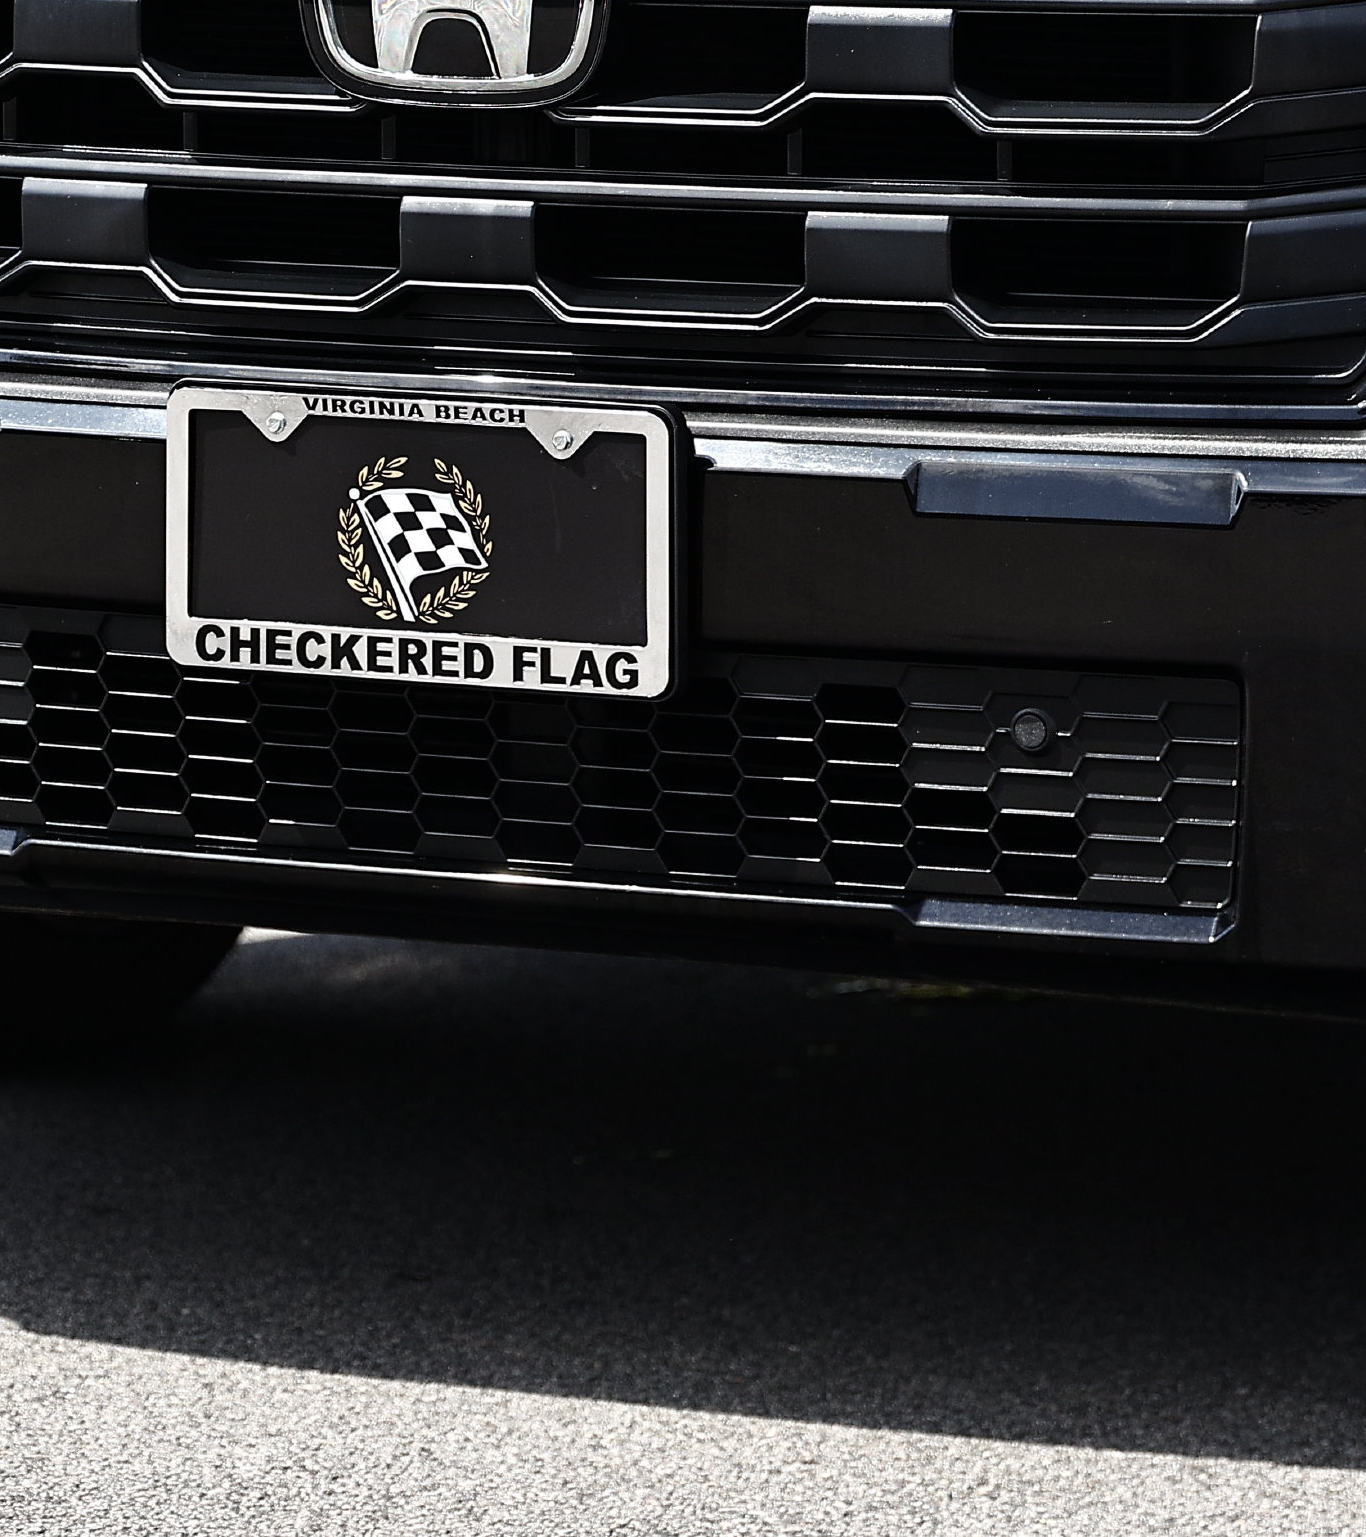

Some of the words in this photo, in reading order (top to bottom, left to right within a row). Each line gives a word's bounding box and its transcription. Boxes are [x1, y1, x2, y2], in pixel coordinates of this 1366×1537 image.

[302, 396, 425, 418] VIRGINIA
[434, 404, 526, 424] BEACH
[194, 623, 495, 681] CHECKERED
[511, 645, 640, 691] FLAG
